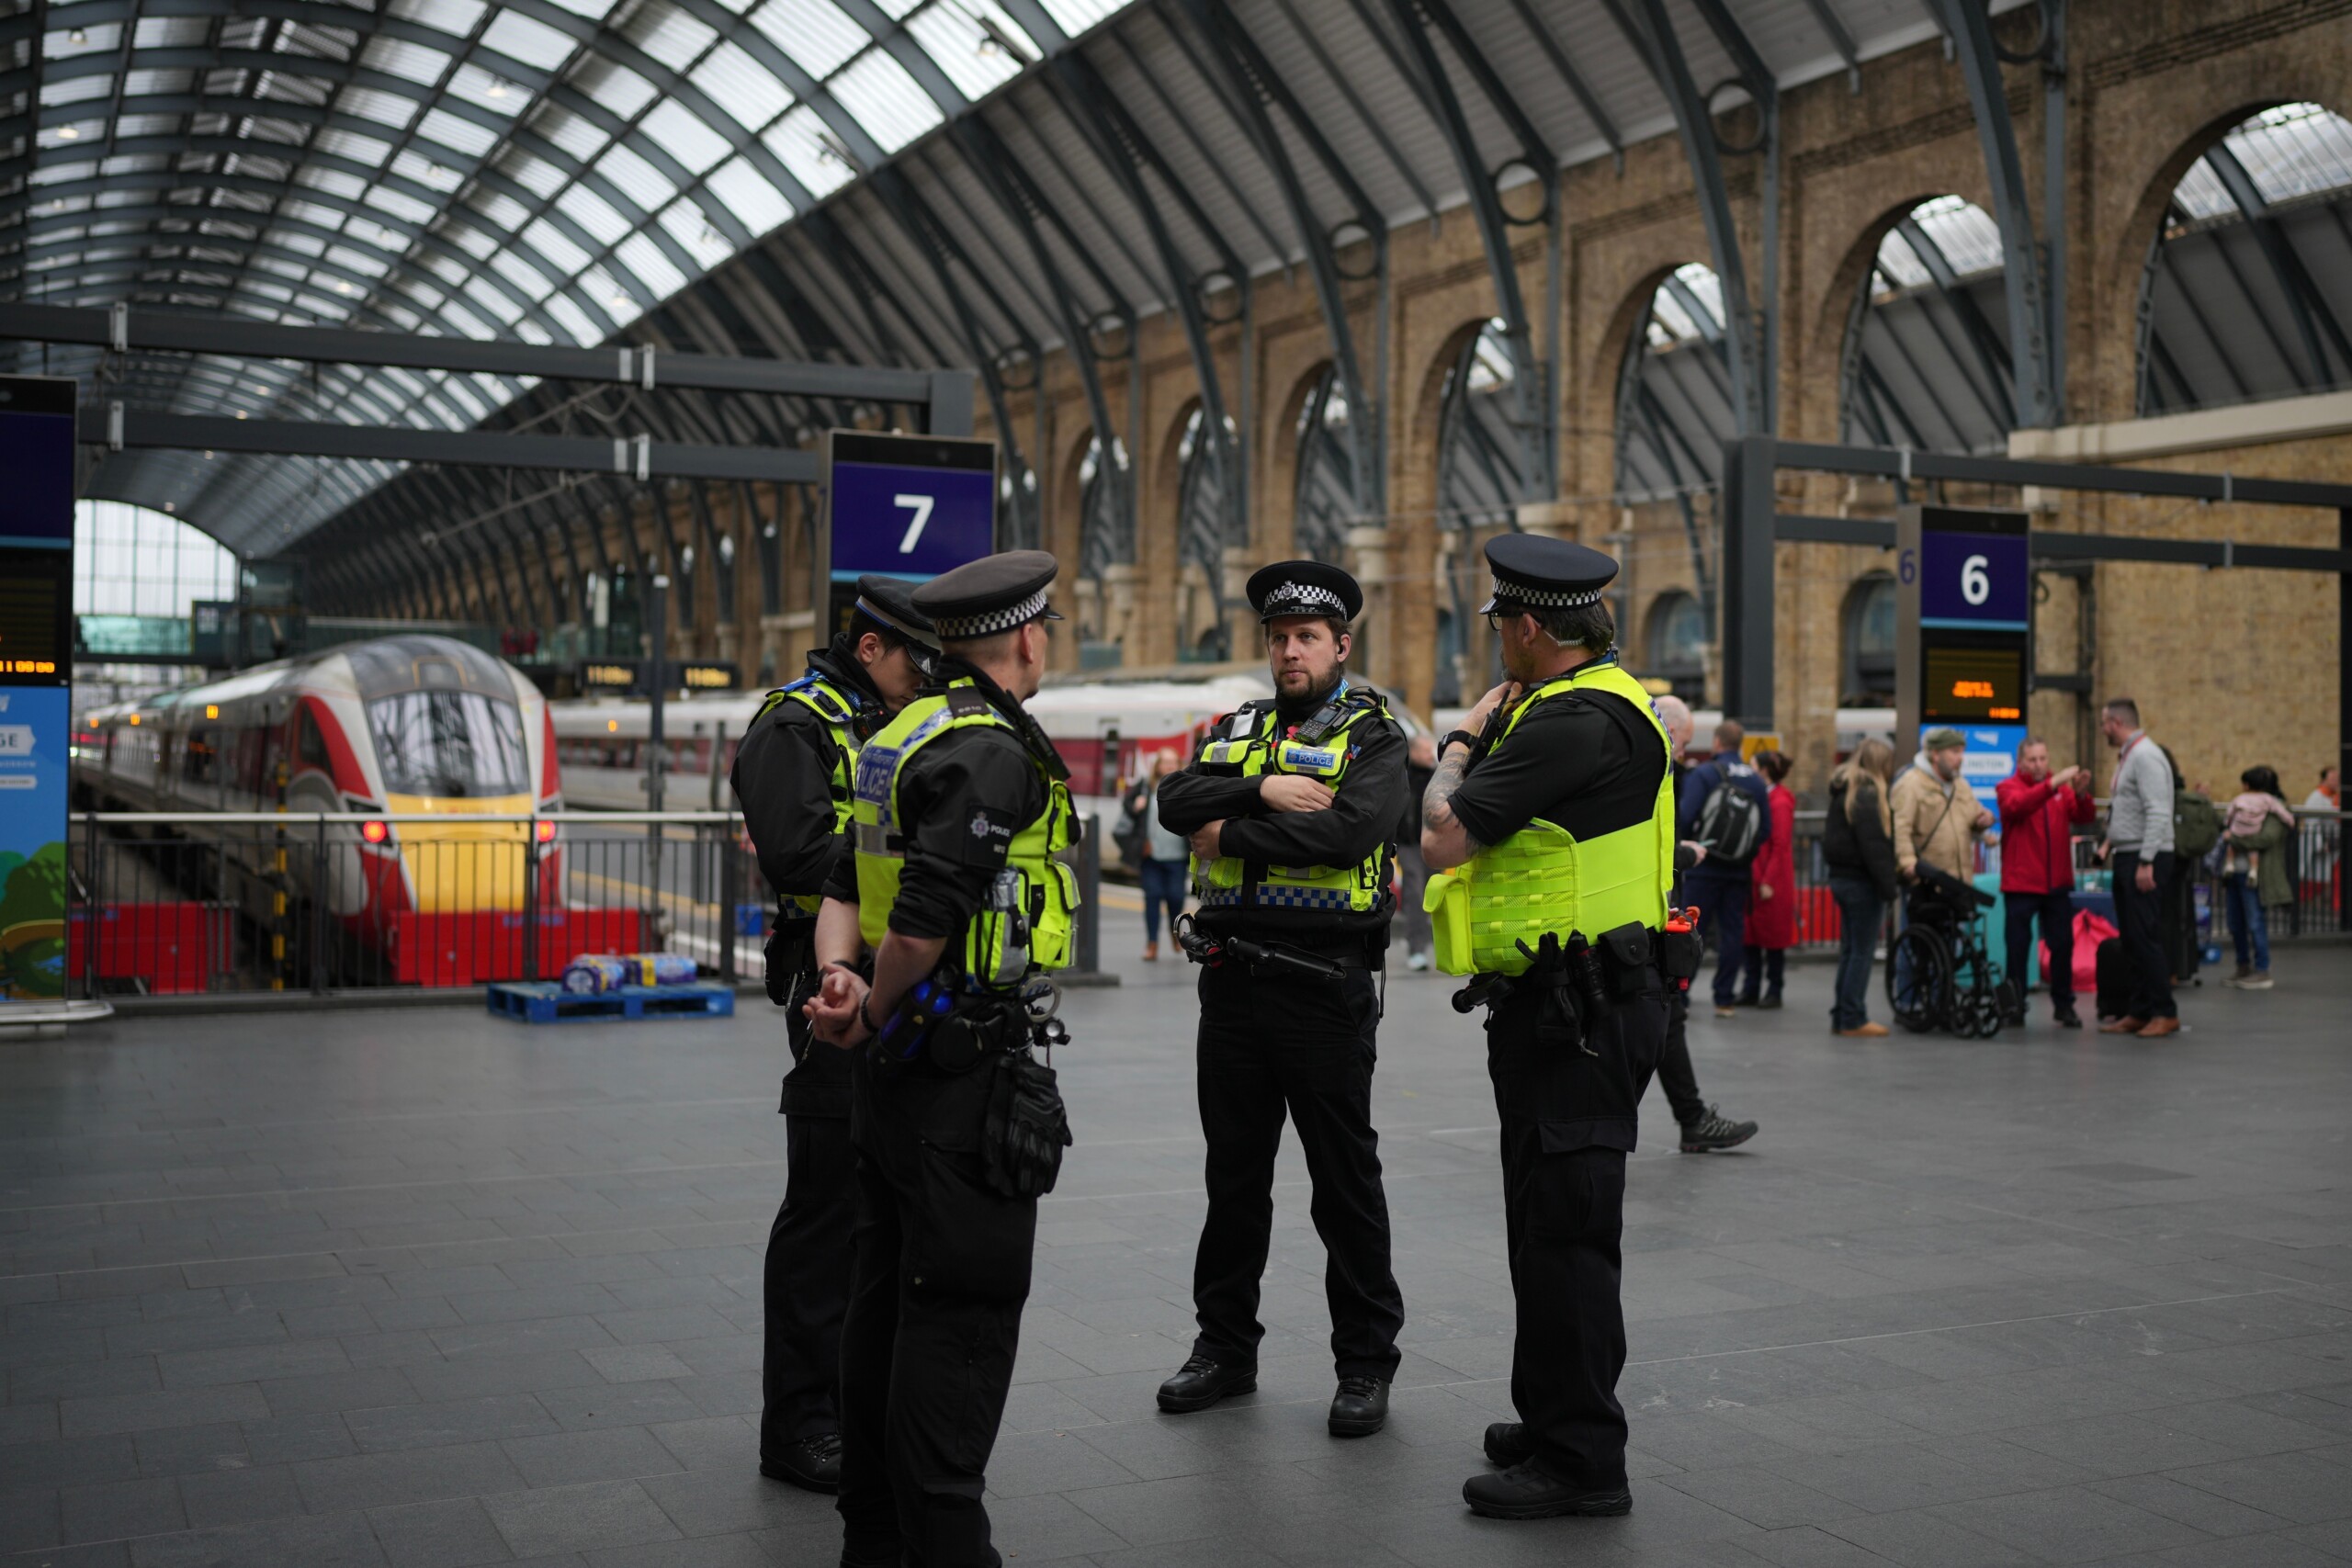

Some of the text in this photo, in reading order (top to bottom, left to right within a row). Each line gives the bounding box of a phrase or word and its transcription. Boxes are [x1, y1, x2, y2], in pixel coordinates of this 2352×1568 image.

[893, 493, 934, 554] 7
[1899, 547, 1916, 586] 6
[1961, 554, 1990, 606] 6
[1298, 755, 1332, 766] POLICE
[990, 825, 1011, 837] POLICE
